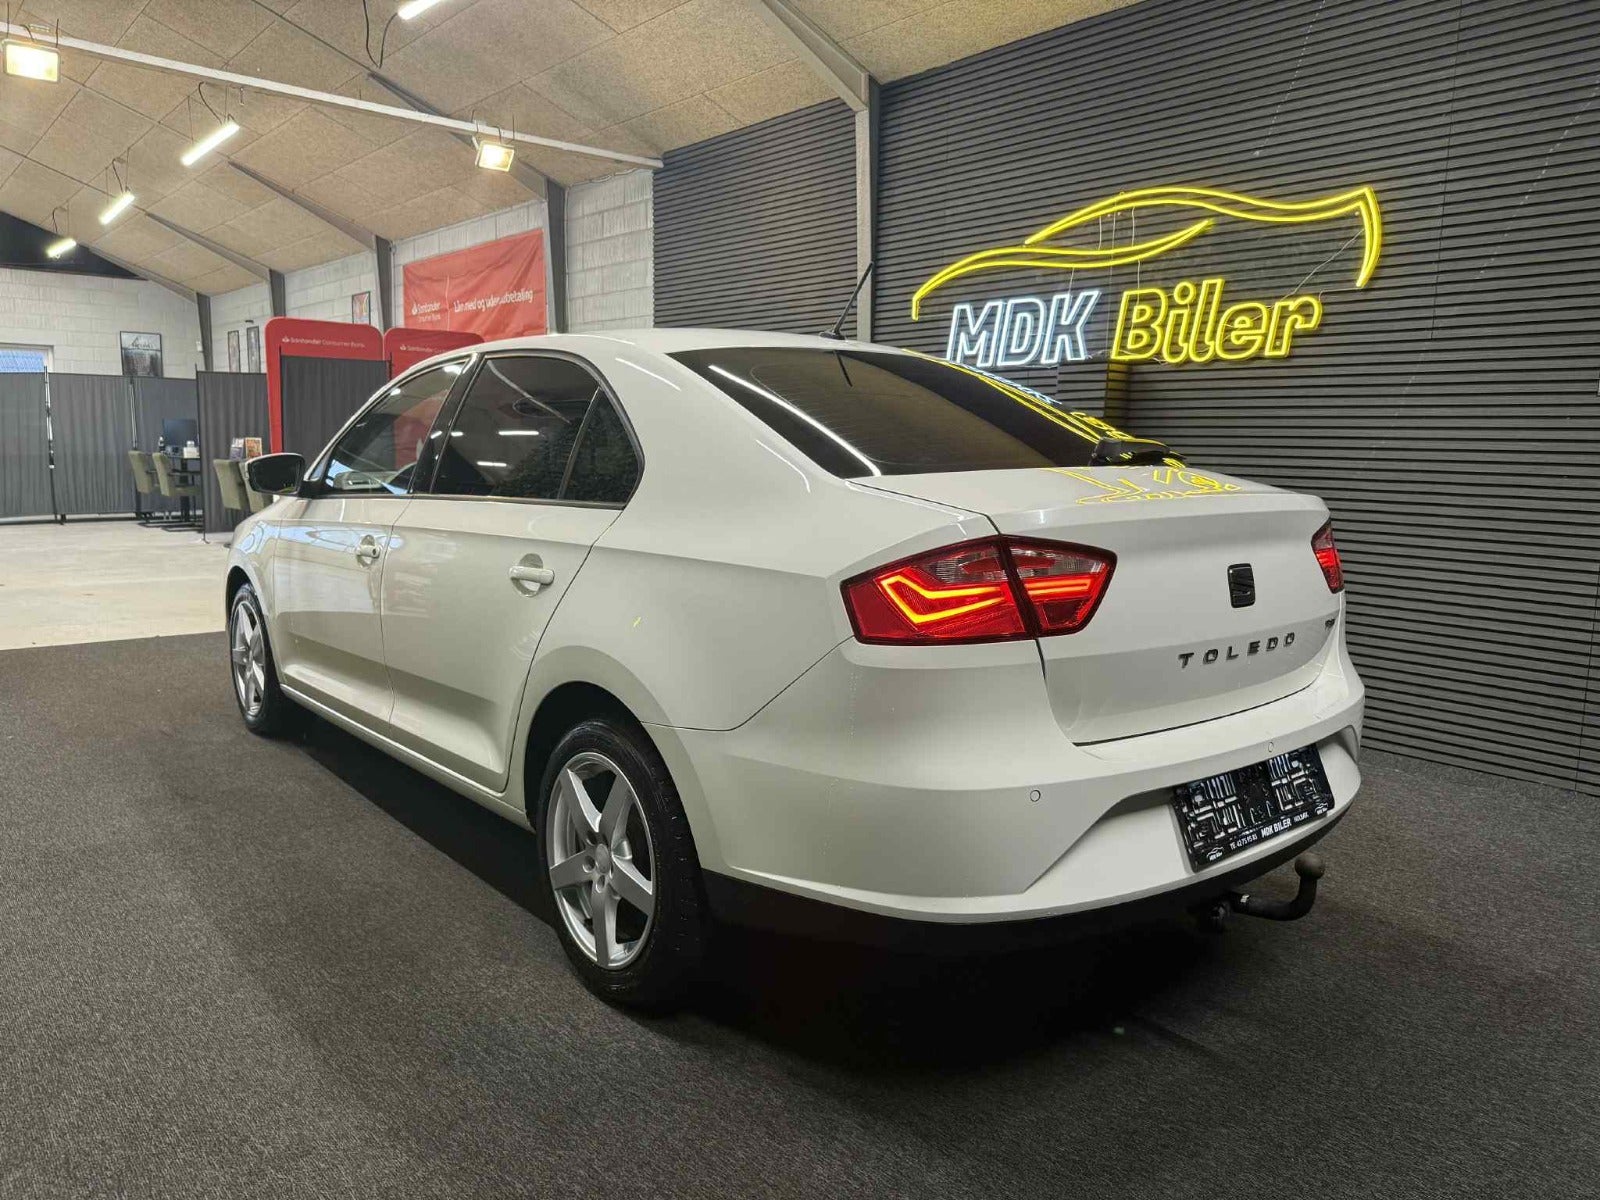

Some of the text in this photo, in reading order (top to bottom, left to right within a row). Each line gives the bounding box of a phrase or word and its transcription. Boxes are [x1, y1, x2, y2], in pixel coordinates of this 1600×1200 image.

[477, 299, 486, 312] og
[946, 279, 1321, 367] MDK Biler
[290, 337, 321, 345] Santander
[1178, 632, 1296, 669] TOLEDO
[1260, 825, 1274, 838] MDK
[1273, 818, 1292, 833] BILER
